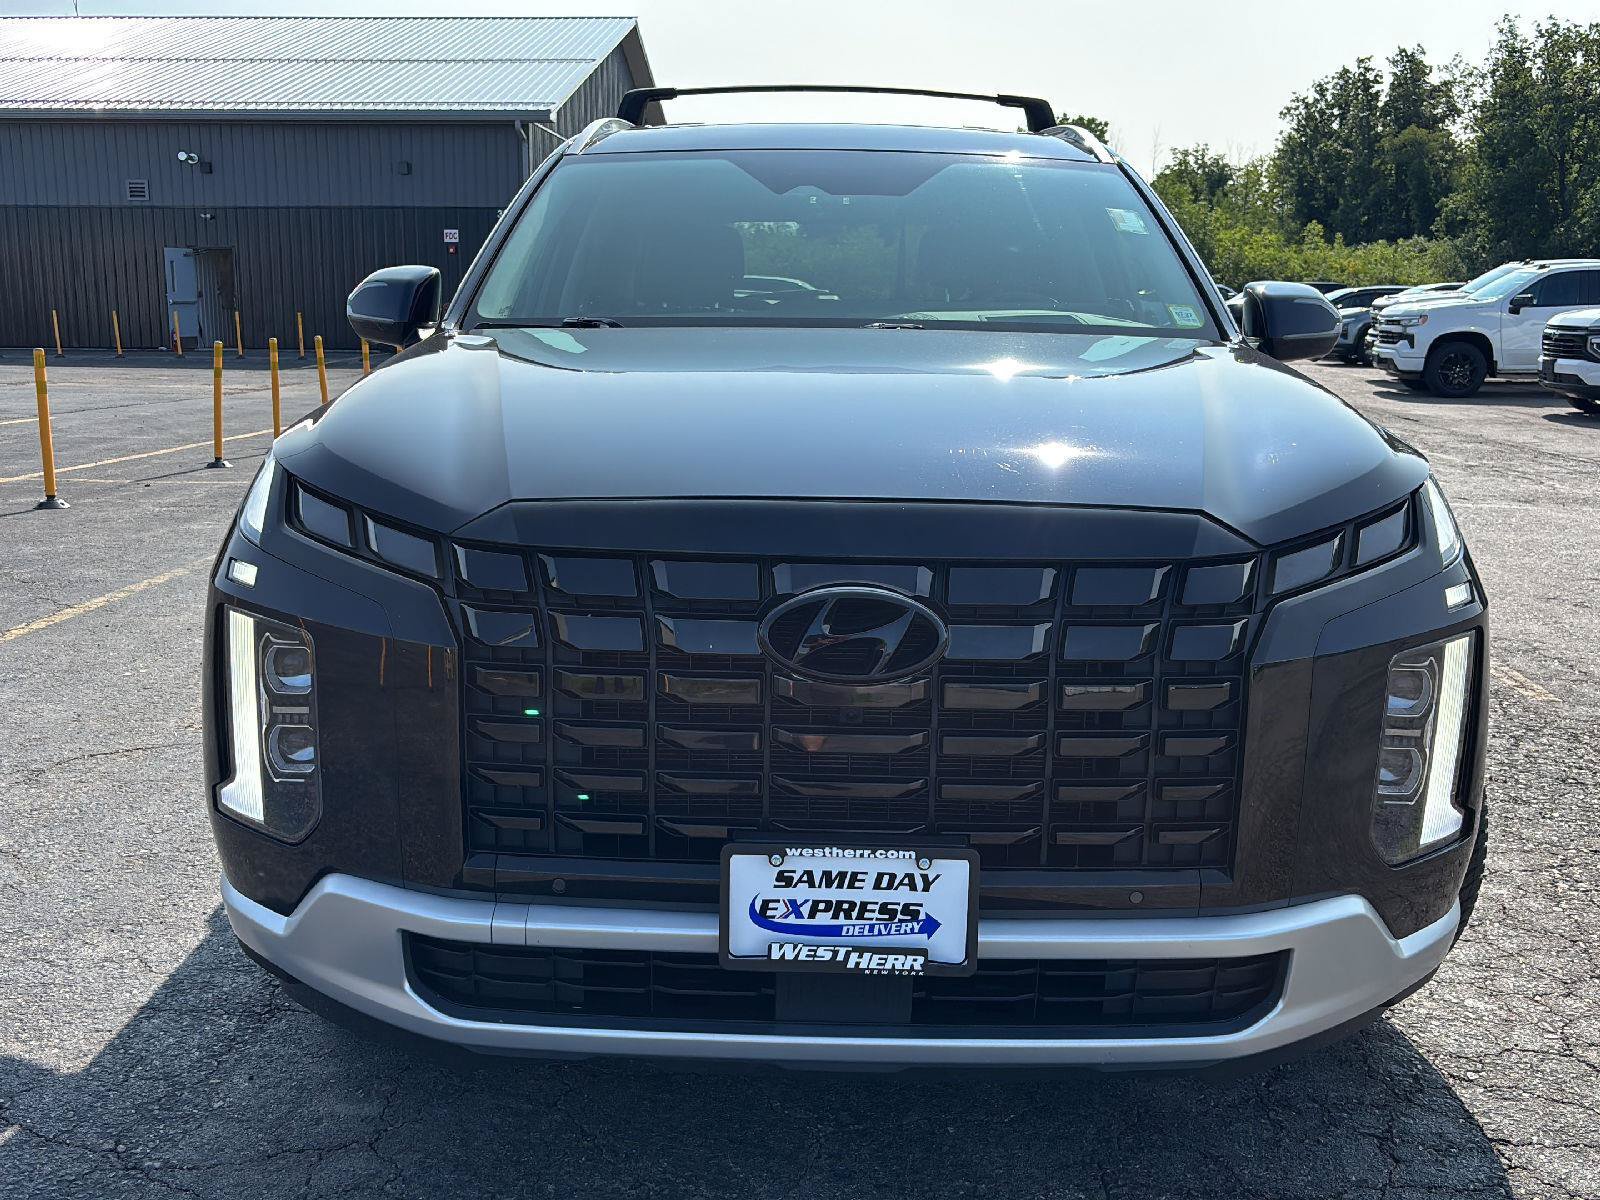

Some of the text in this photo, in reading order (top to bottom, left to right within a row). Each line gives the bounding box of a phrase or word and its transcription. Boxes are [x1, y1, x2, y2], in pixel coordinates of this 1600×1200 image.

[445, 232, 458, 240] FDC
[785, 847, 916, 859] westherr.com
[773, 869, 942, 893] SAME DAY
[759, 899, 923, 921] EXPRESS
[841, 922, 924, 936] DELIVERY
